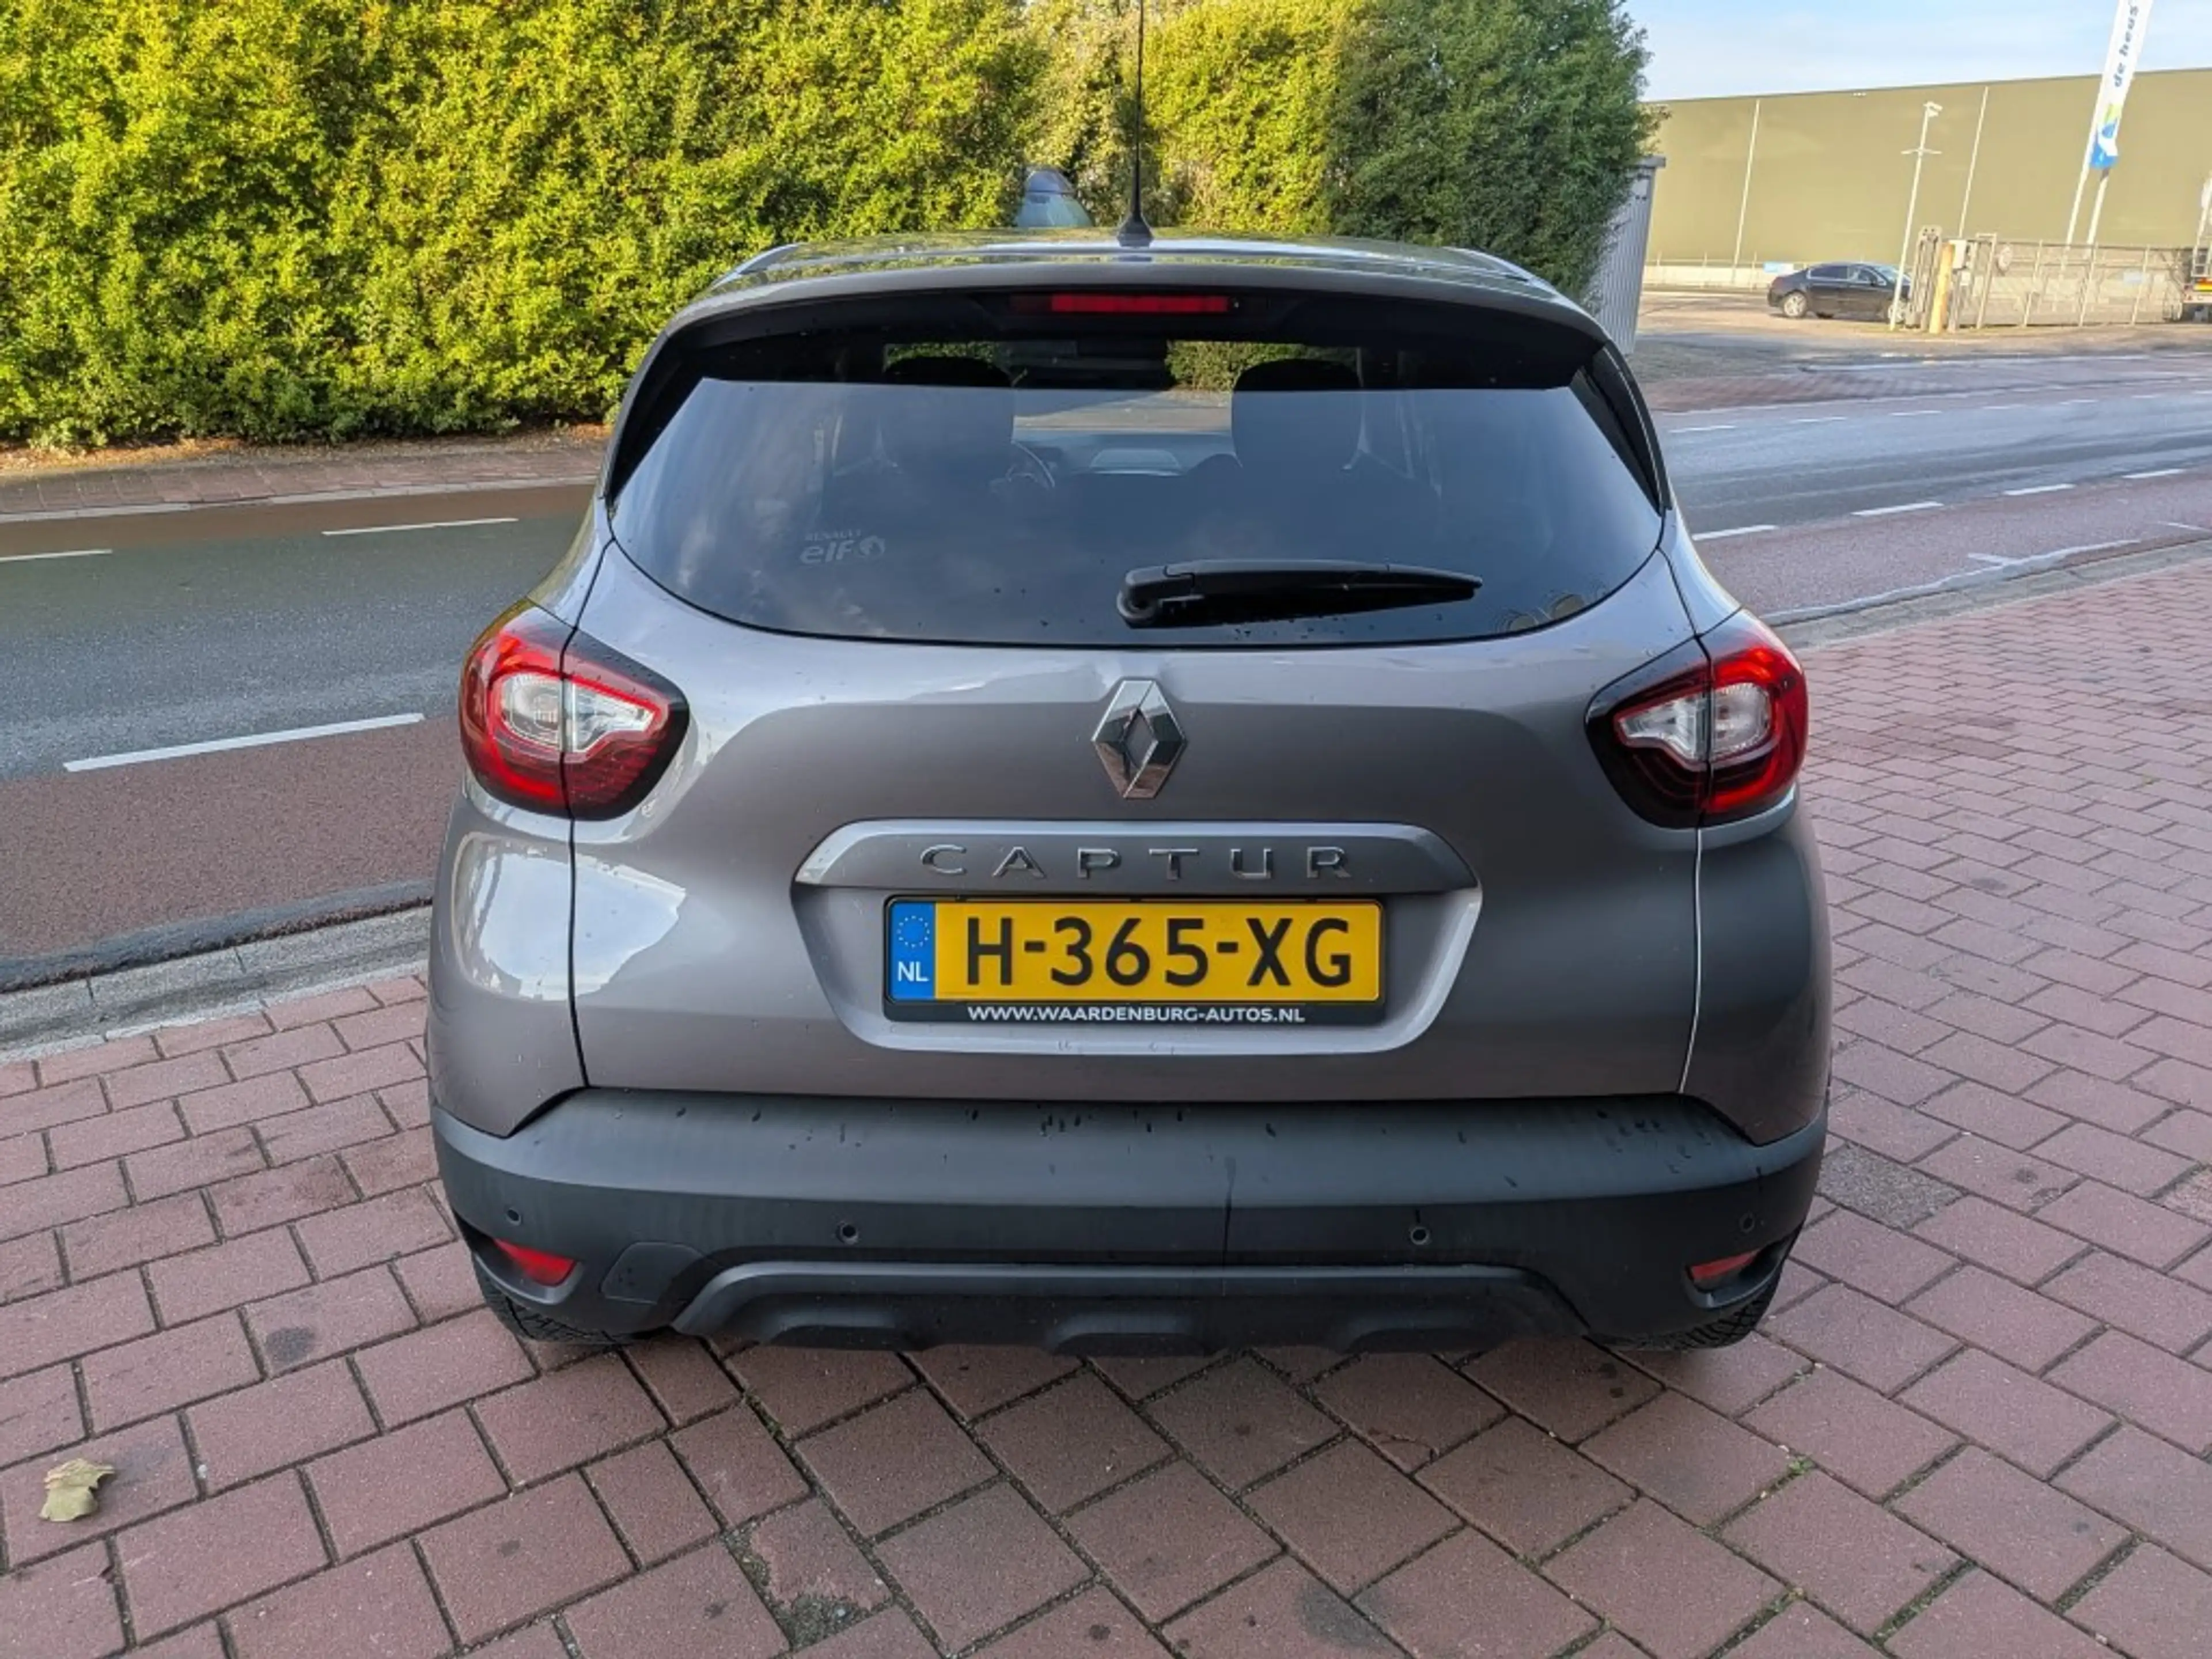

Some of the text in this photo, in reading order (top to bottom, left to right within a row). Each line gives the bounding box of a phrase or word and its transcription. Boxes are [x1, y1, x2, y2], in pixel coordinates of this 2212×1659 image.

[2114, 5, 2138, 87] de heus
[921, 844, 1351, 879] CAPTUR
[967, 917, 1352, 986] H-365-XG
[898, 961, 930, 982] NL
[968, 1006, 1305, 1022] WWW.WAARDENBURG-AUTOS.NL
